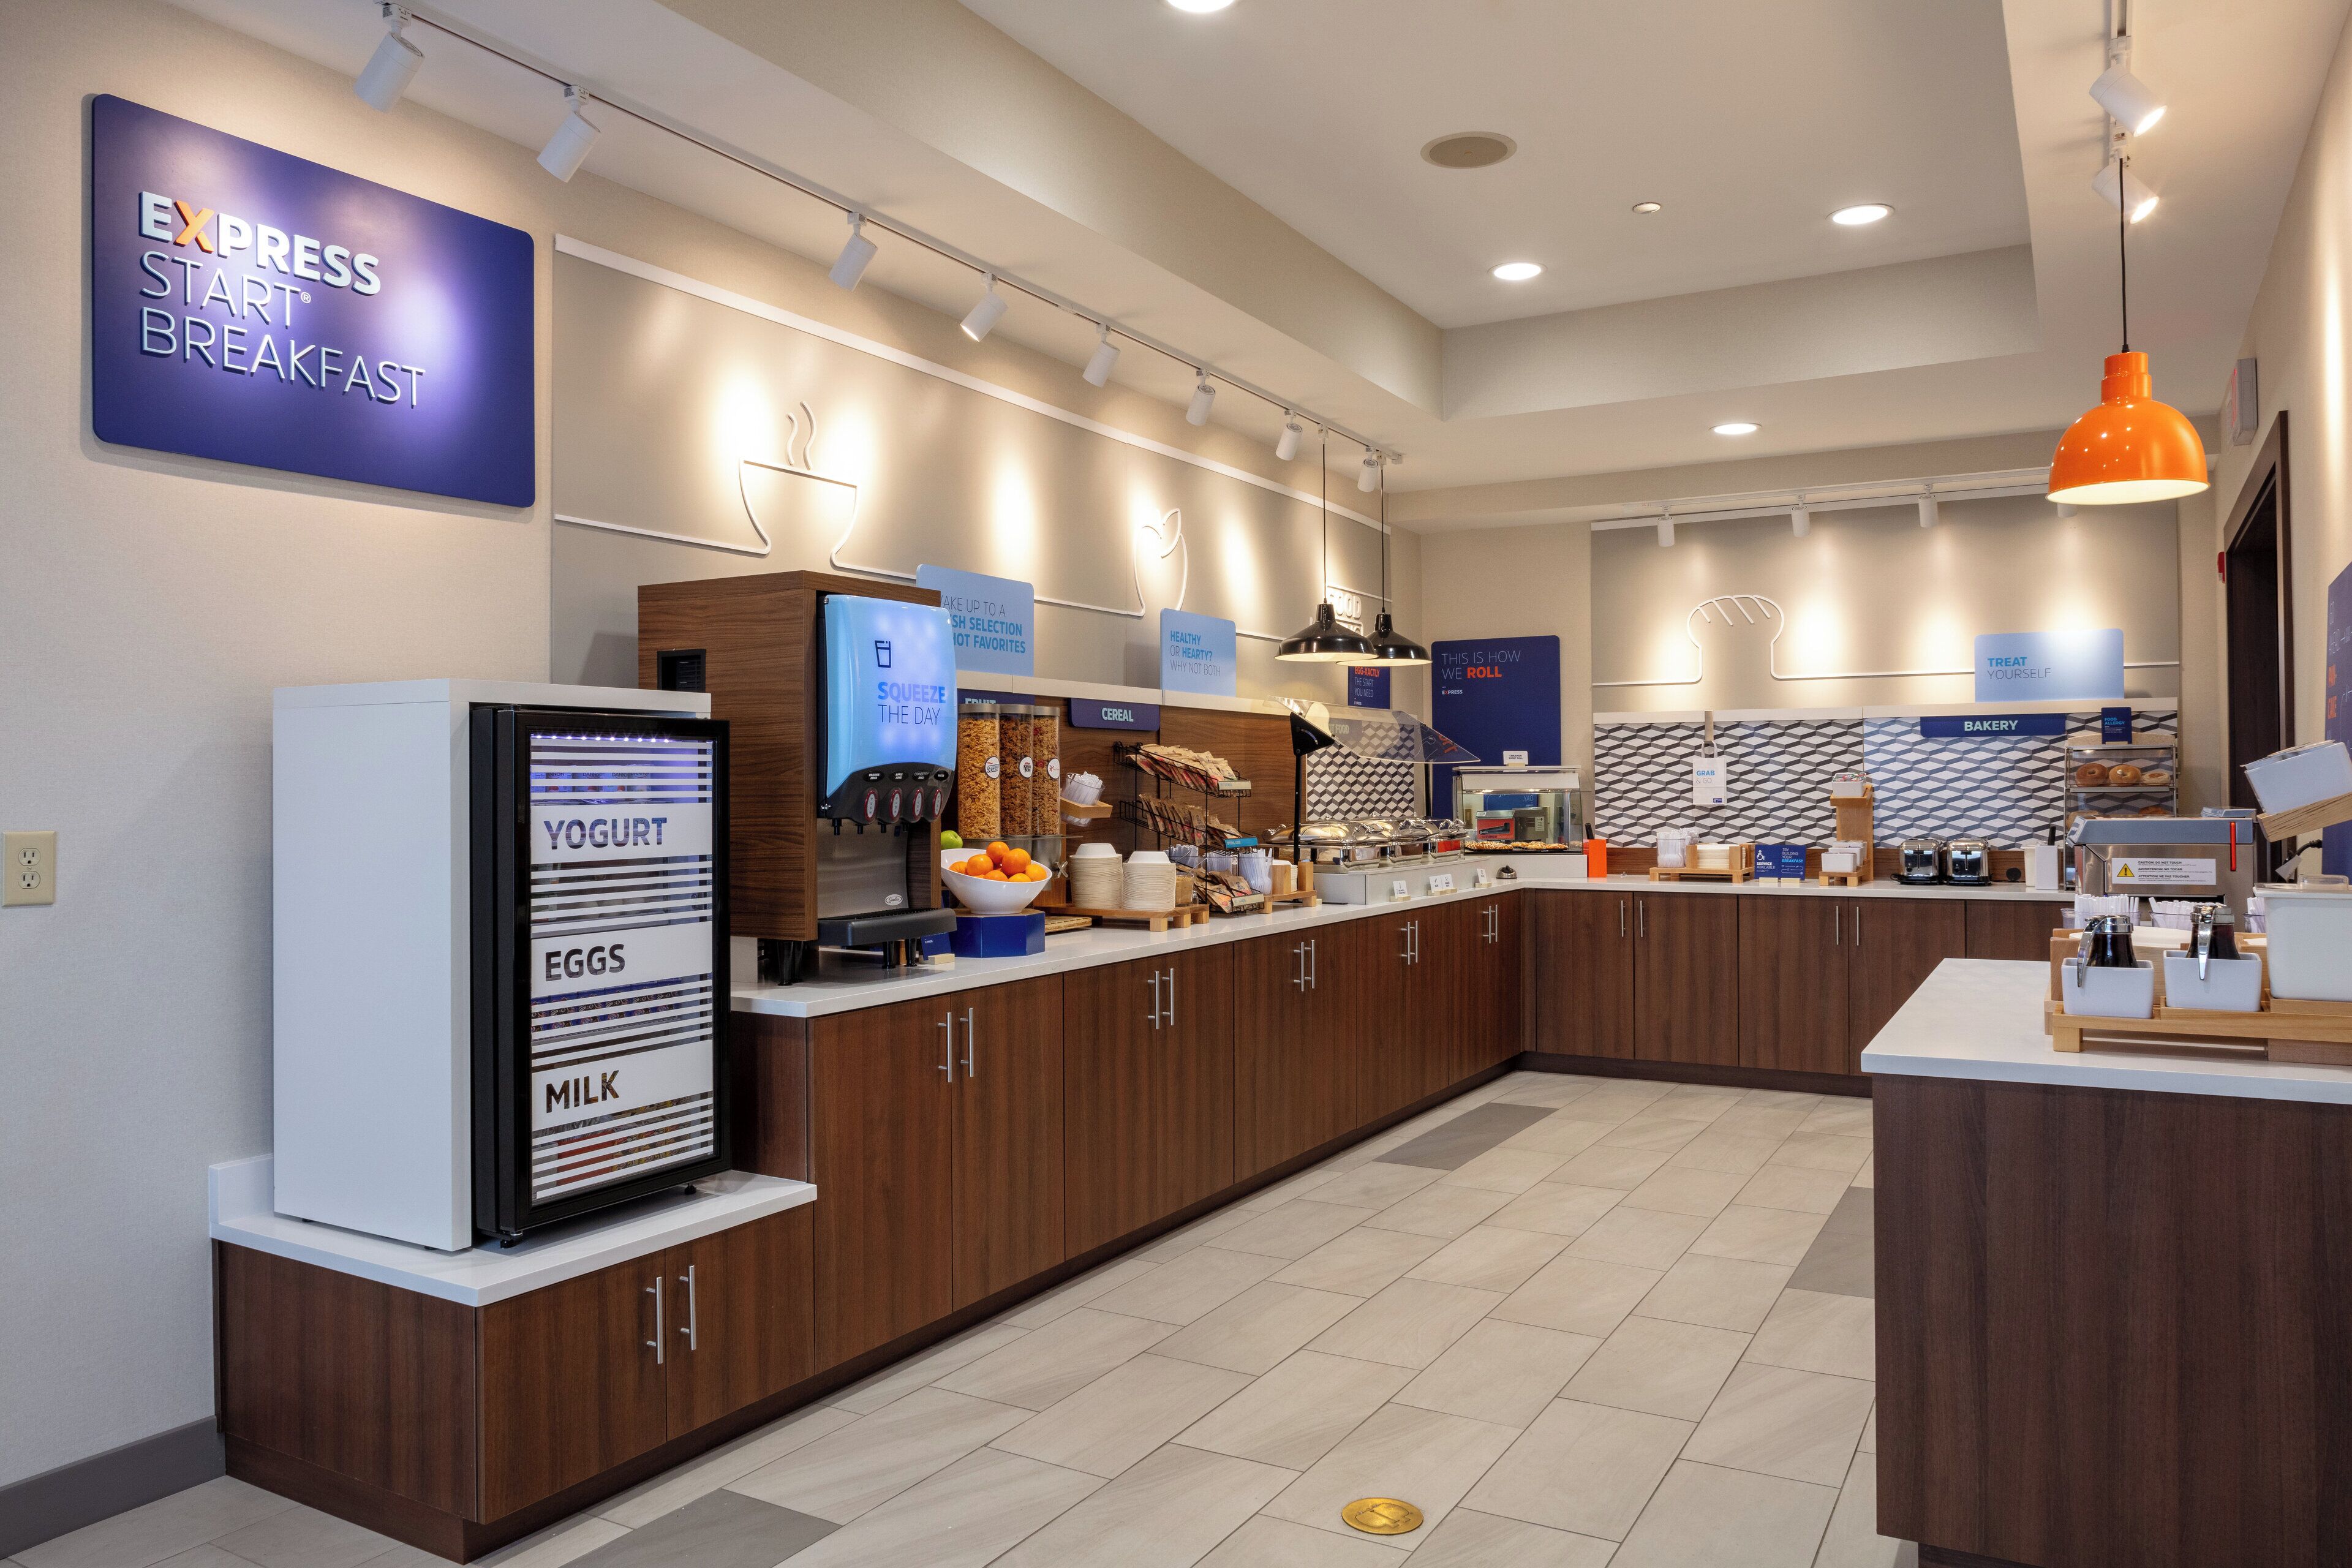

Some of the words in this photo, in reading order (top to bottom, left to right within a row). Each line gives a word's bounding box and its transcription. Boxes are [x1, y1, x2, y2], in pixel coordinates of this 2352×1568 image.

[139, 190, 381, 295] EXPRESS
[141, 307, 425, 408] BREAKFAST
[940, 595, 962, 611] AKE
[967, 599, 979, 612] UP
[984, 601, 995, 616] TO
[999, 604, 1006, 617] A
[969, 617, 1022, 636] SELECTION
[973, 635, 1026, 654] FAVORITES
[1170, 630, 1201, 646] HEALTHY
[1170, 645, 1180, 657] OR
[1182, 647, 1213, 662] HEARTY?
[1441, 652, 1469, 665] THIS
[1474, 652, 1483, 664] IS
[1488, 650, 1521, 663] HOW
[1170, 660, 1187, 673] WHY
[1189, 662, 1202, 674] NOT
[1204, 664, 1221, 676] BOTH
[1988, 657, 2027, 667] TREAT
[1354, 666, 1379, 677] EGG-XACTLY
[1442, 667, 1462, 679] WE
[1467, 666, 1502, 679] ROLL
[1987, 668, 2051, 680] YOURSELF
[1363, 678, 1374, 687] START
[878, 682, 946, 704] SQUEEZE
[1363, 688, 1374, 698] NEED
[878, 704, 908, 724] THE
[914, 706, 940, 725] DAY
[1101, 707, 1134, 722] CEREAL
[1964, 720, 2019, 731] BAKERY
[543, 817, 668, 850] YOGURT
[546, 944, 625, 981] EGGS
[546, 1070, 619, 1114] MILK
